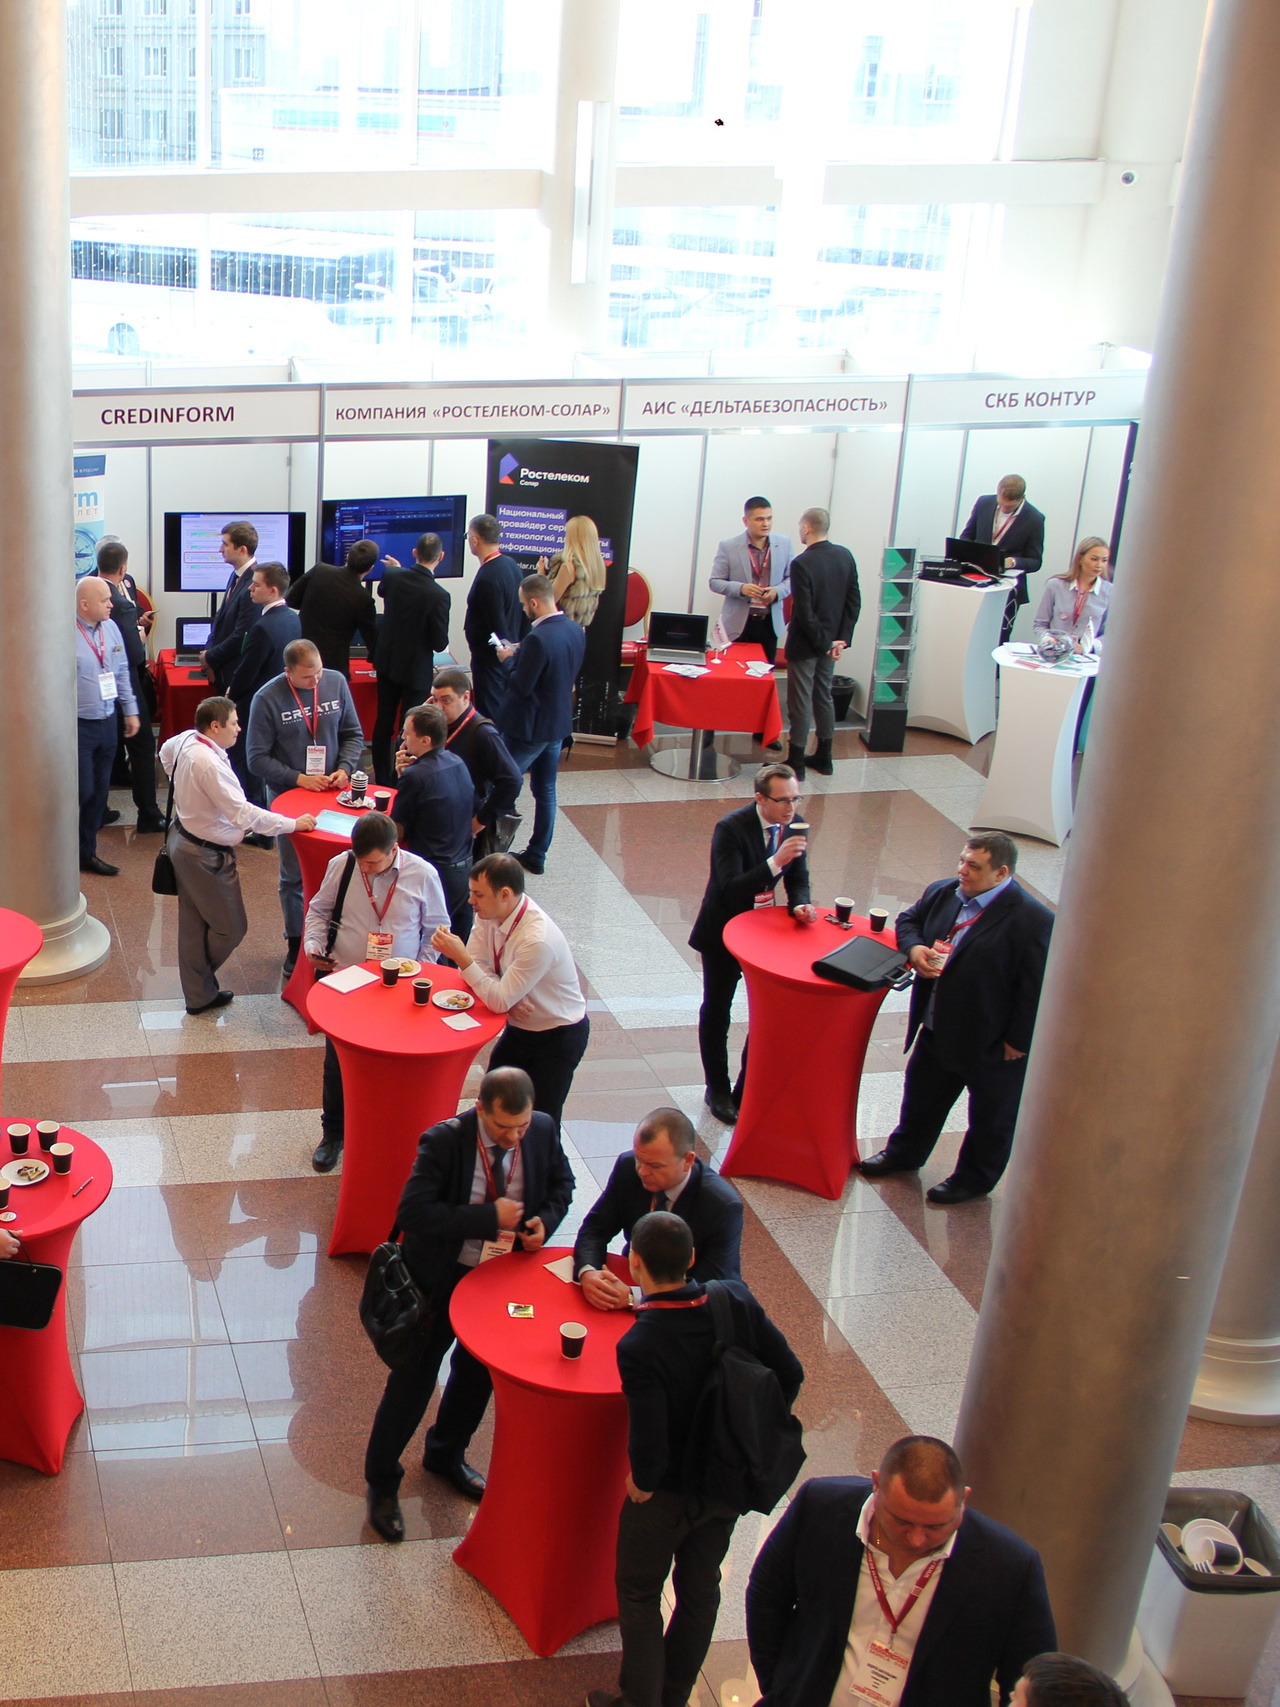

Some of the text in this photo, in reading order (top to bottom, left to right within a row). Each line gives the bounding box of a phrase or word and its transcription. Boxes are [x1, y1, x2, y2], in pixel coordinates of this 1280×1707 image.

[642, 397, 888, 417] АИС «ДЕЛЬТАБЕЗОПАСНОСТЬ»
[985, 391, 1096, 408] СКБ КОНТУР
[101, 406, 235, 425] CREDINFORM
[336, 403, 611, 420] КОМПАНИЯ «РОСТЕЛЕКОМ-СОЛАР»
[520, 468, 590, 483] Ростелеком
[519, 479, 539, 488] Солар
[499, 507, 564, 520] Национальный
[498, 520, 546, 532] провайдер
[505, 531, 555, 543] технологий
